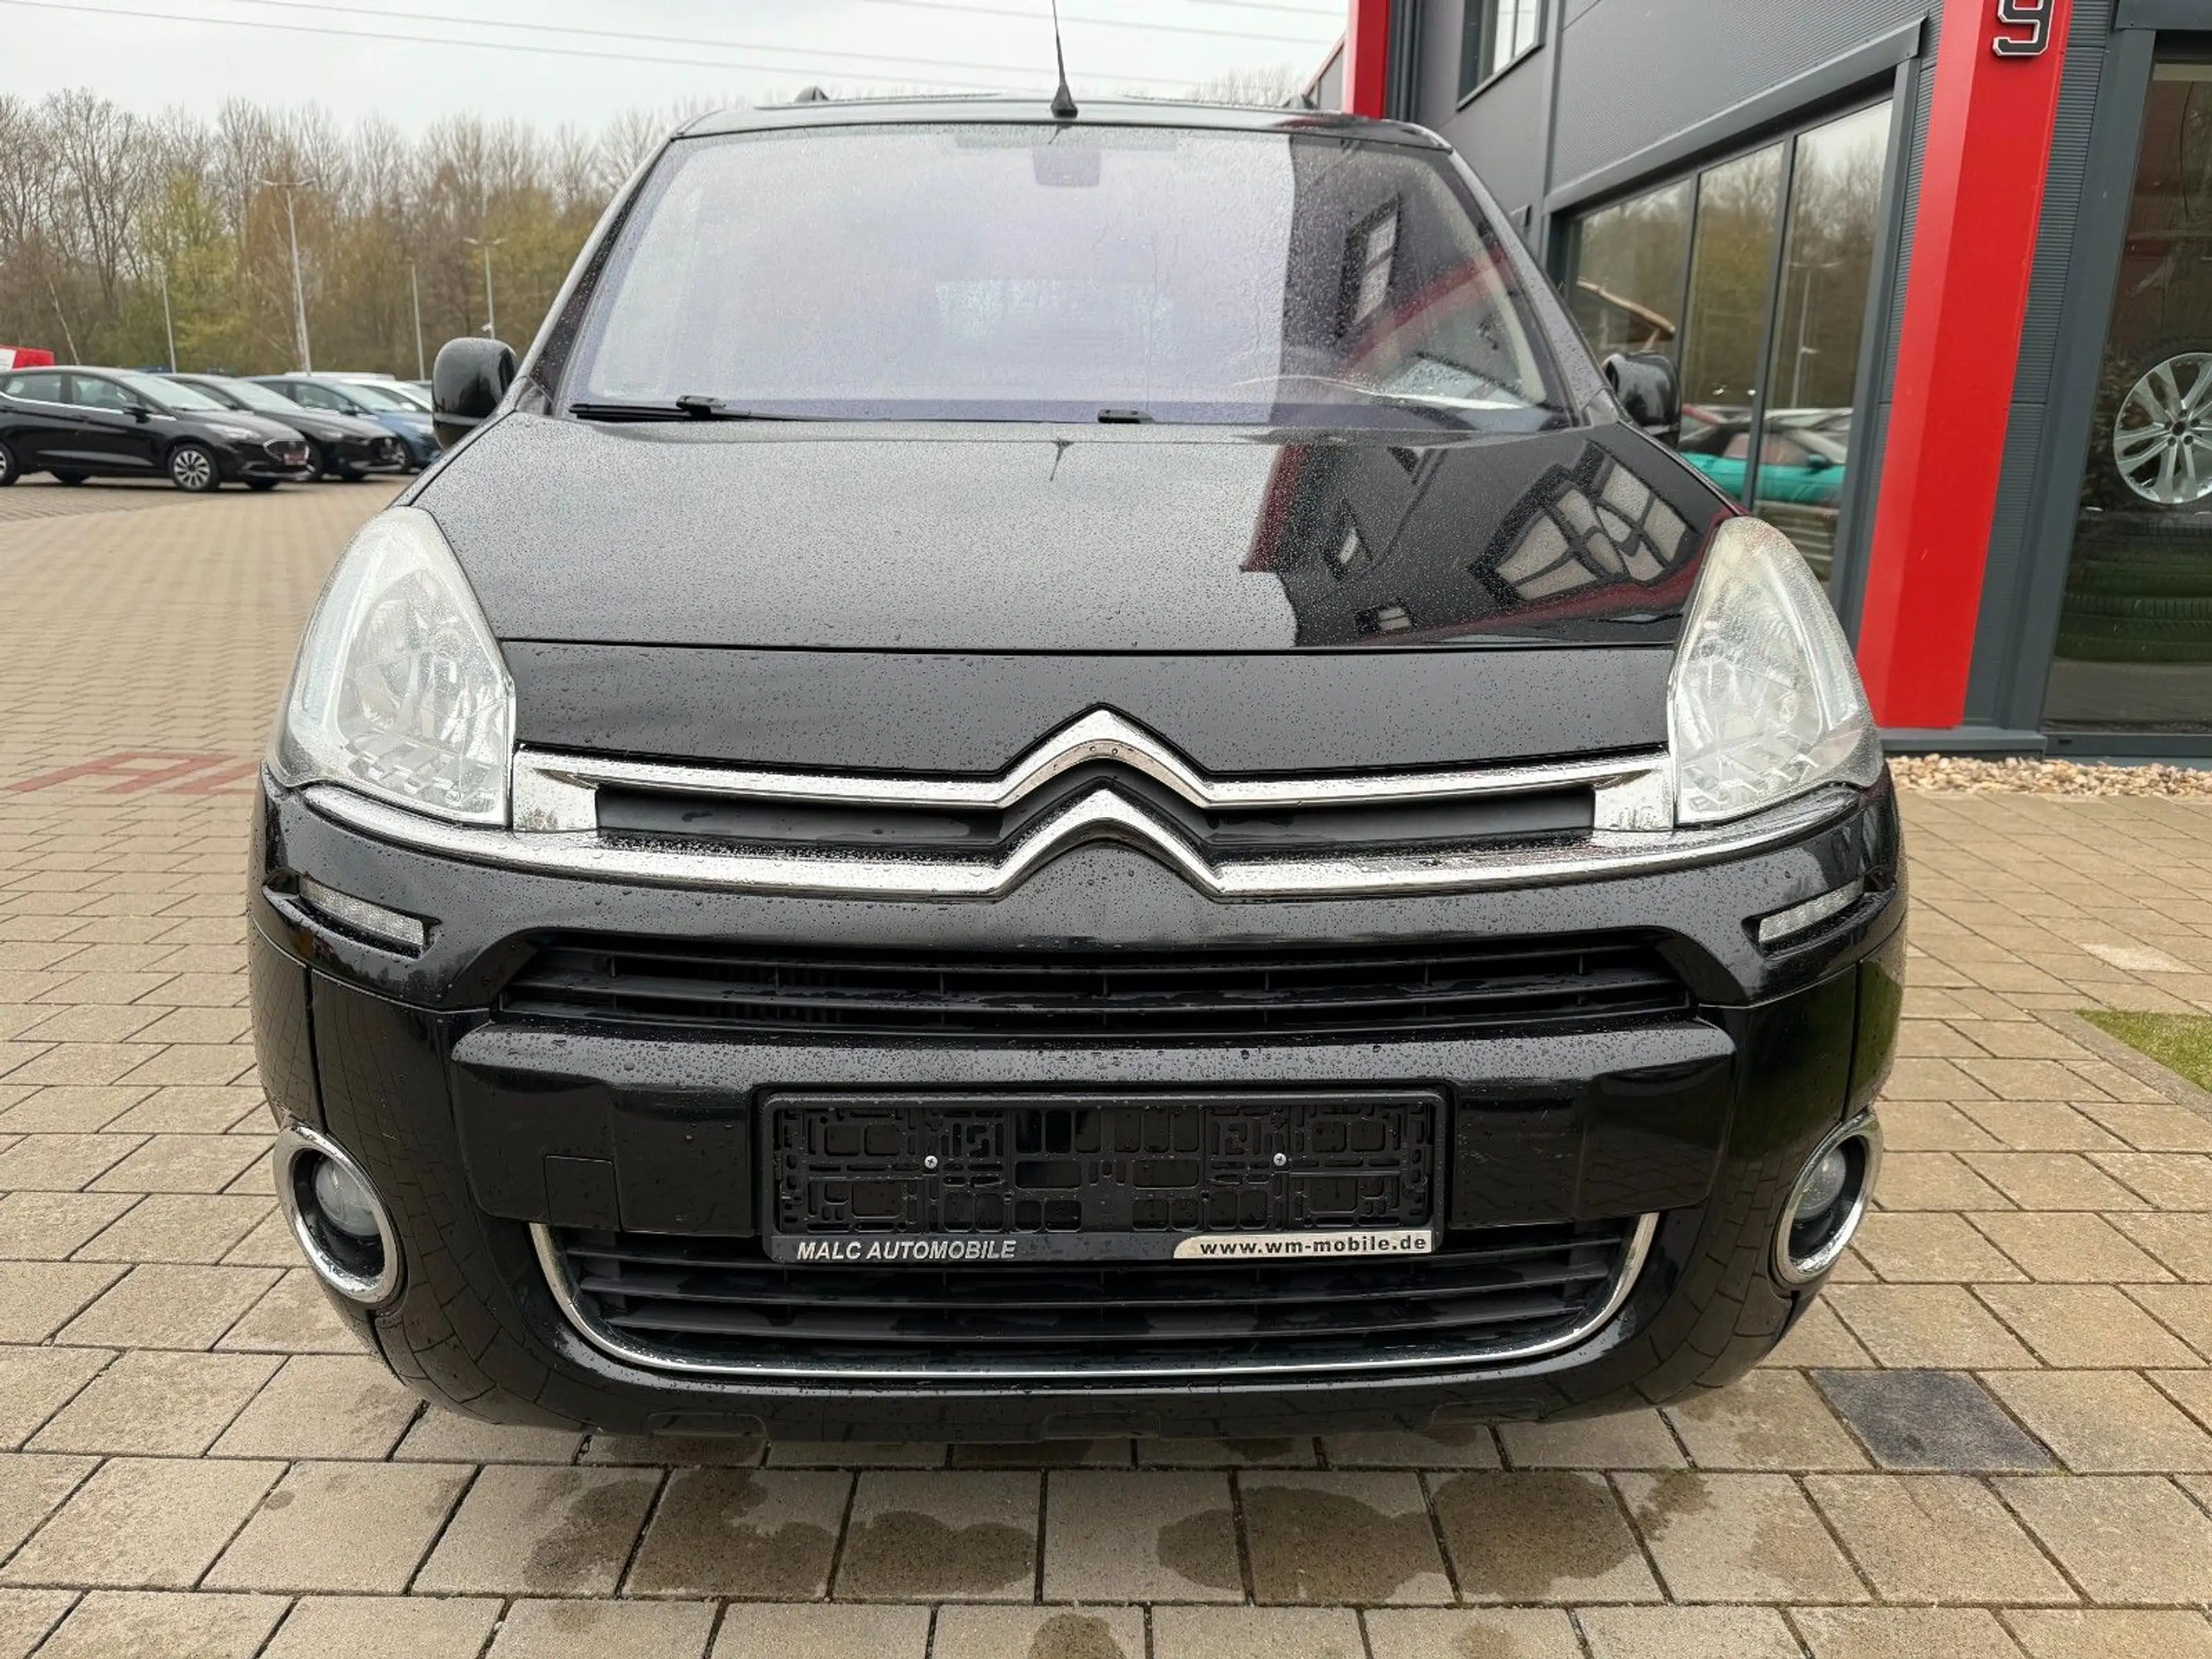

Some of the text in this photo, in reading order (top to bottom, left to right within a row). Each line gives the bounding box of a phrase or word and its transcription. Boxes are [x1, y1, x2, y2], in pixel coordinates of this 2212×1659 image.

[797, 1240, 1017, 1260] MALC AUTOMOBILE
[1200, 1234, 1427, 1255] www.wm-mobile.de
